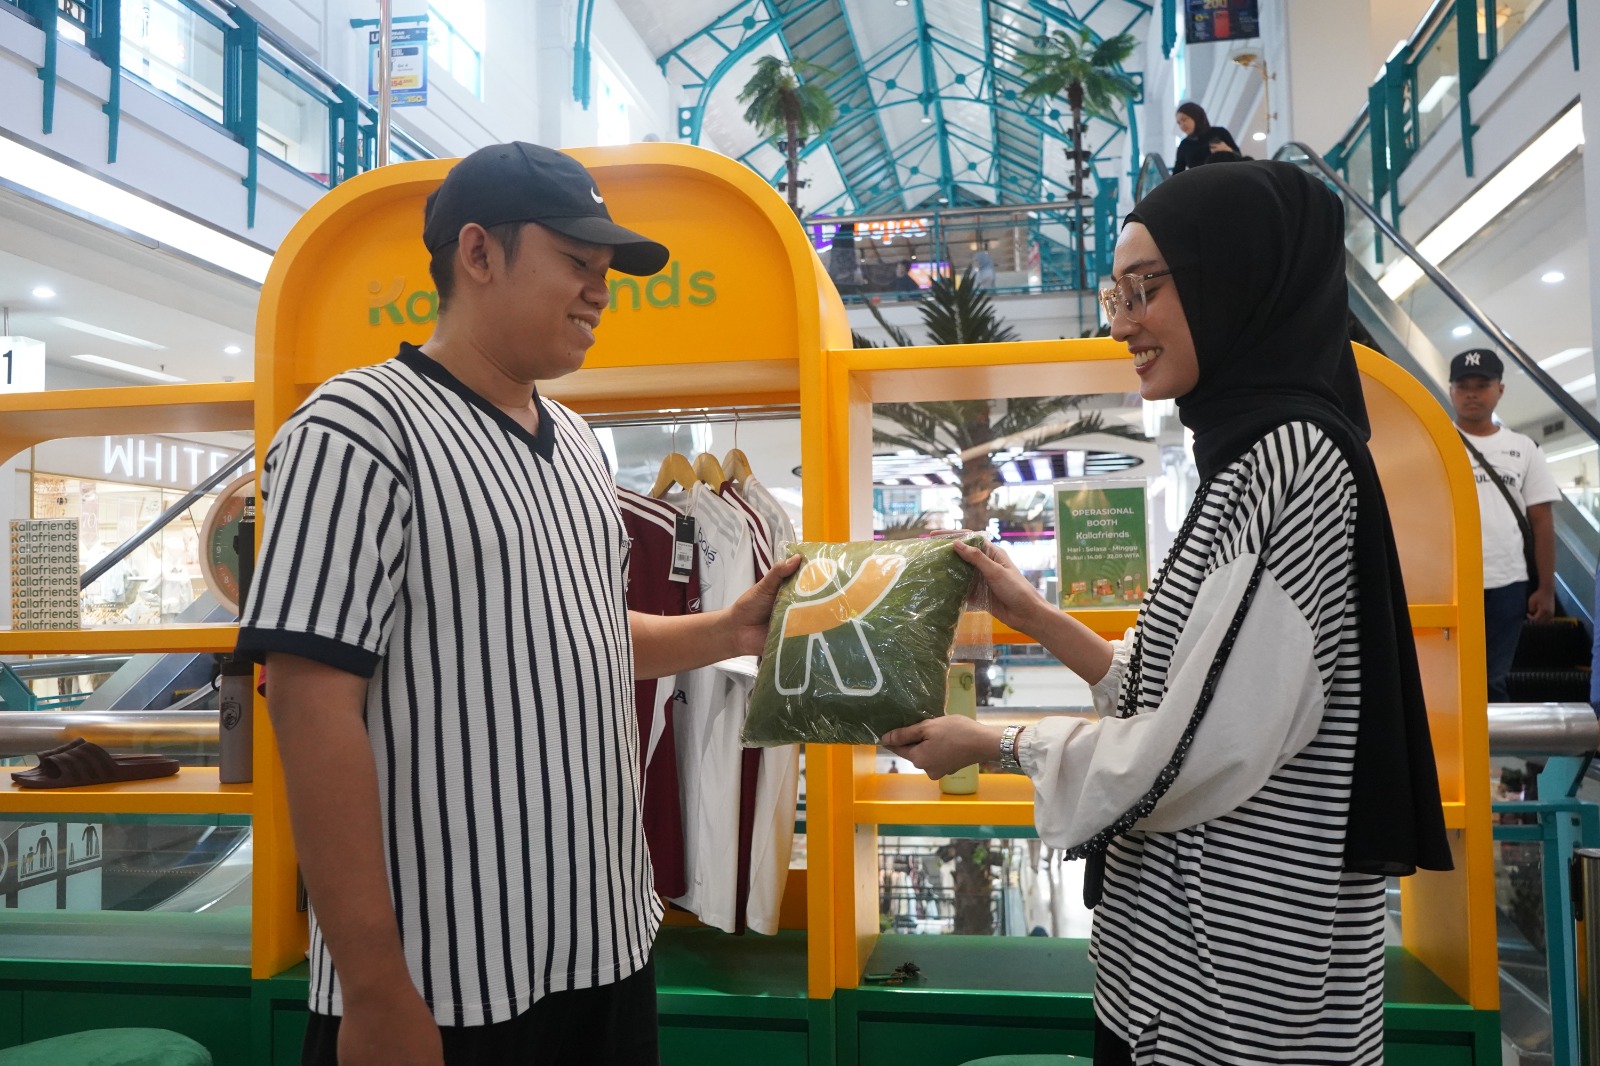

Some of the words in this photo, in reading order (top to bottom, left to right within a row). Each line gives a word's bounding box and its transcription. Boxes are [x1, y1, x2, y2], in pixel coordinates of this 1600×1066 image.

[3, 350, 13, 385] 1
[1072, 508, 1134, 516] OPERASIONAL
[224, 515, 232, 524] 10
[11, 520, 77, 531] Kallafriends
[11, 531, 77, 543] Kallafriends
[1076, 530, 1130, 540] Kallafriends
[11, 542, 77, 554] Kallafriends
[1112, 544, 1138, 553] Minggu
[11, 554, 78, 564] Kallafriends
[12, 565, 78, 575] Kallafriends
[12, 576, 78, 586] Kallafriends
[12, 587, 78, 597] Kallafriends
[12, 598, 78, 608] Kallafriends
[12, 609, 78, 619] Kallafriends
[12, 620, 78, 630] Kallafriends
